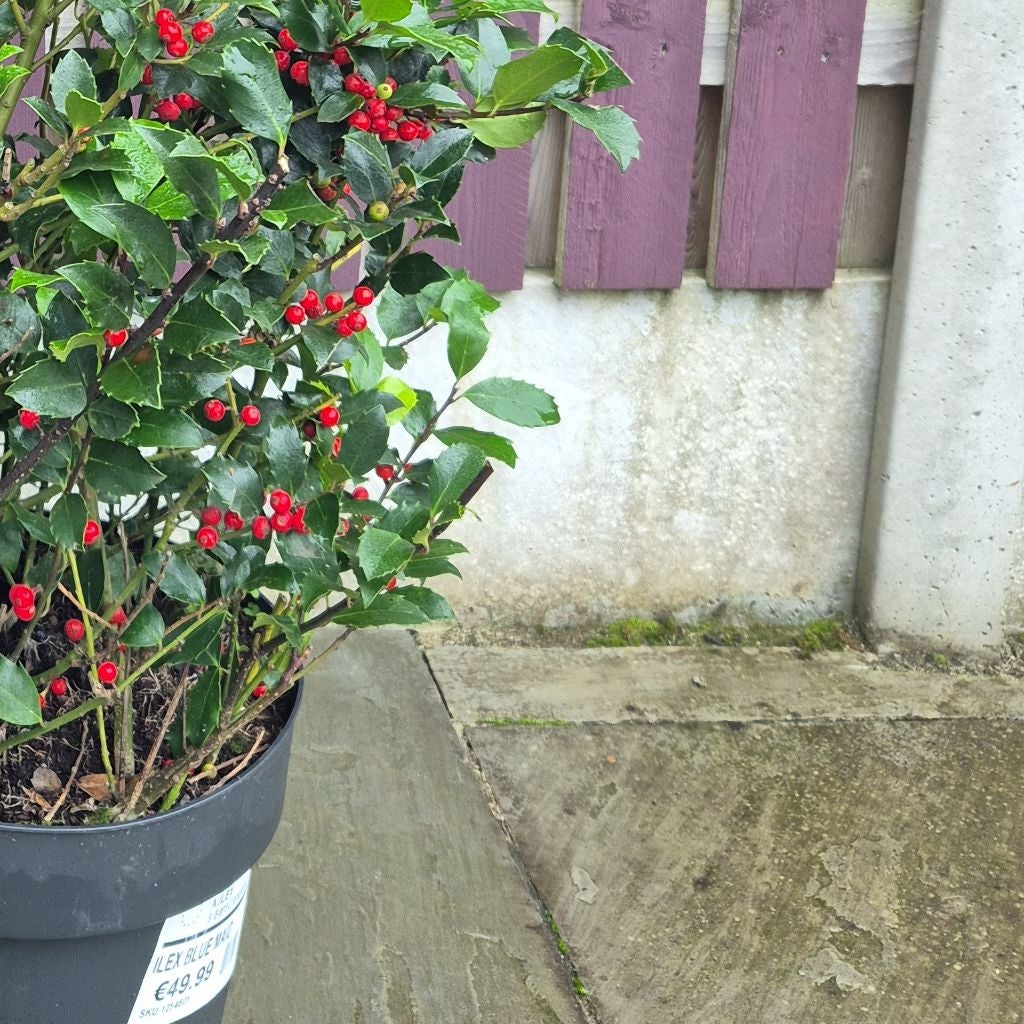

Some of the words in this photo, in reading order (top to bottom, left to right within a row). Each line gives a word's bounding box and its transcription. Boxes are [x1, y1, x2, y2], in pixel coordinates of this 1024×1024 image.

[153, 950, 183, 973] ILEX
[184, 937, 214, 966] BLUE
[155, 960, 214, 1001] €49.99
[139, 1007, 158, 1018] SKU
